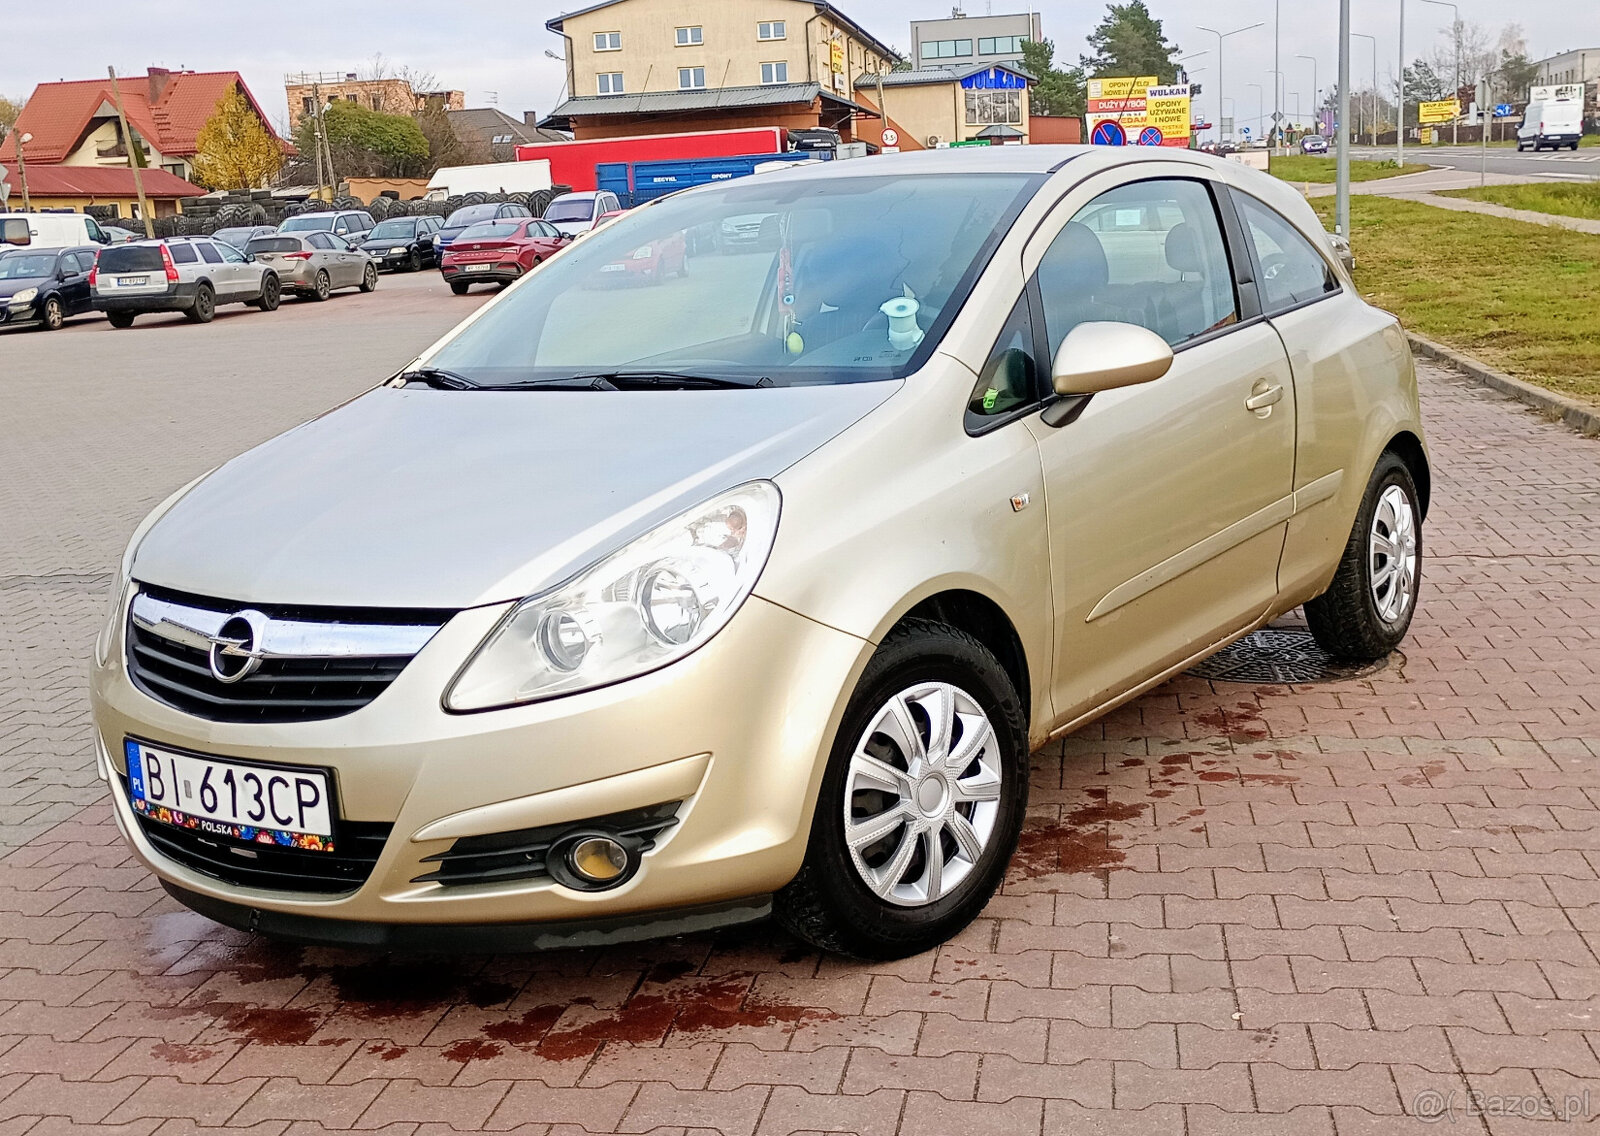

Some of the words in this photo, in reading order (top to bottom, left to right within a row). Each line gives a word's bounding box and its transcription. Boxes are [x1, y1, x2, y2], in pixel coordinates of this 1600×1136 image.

[960, 68, 1026, 89] WULKAN
[1149, 87, 1187, 97] WULKAN
[1098, 100, 1118, 110] DUŻY
[1119, 99, 1146, 108] WYBÓR
[132, 777, 144, 793] PL
[145, 751, 181, 807] BI
[199, 765, 321, 829] 613CP
[200, 818, 233, 836] POLSKA
